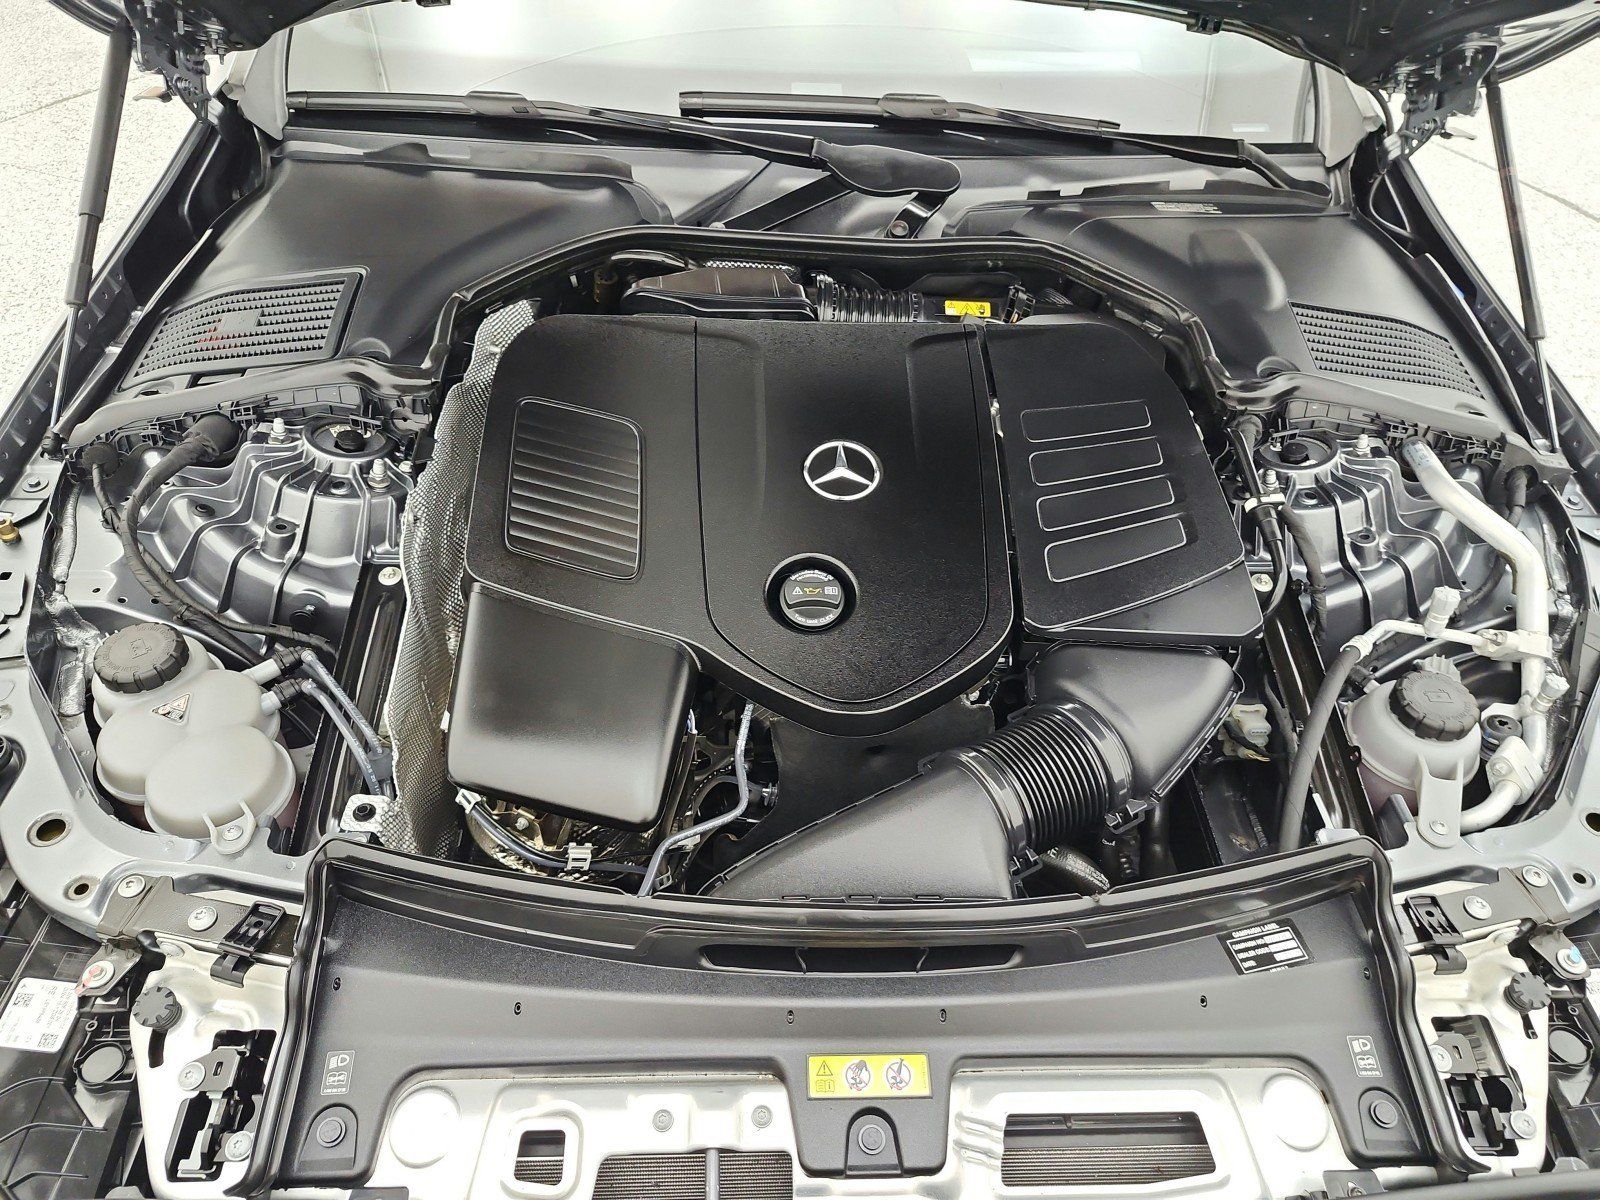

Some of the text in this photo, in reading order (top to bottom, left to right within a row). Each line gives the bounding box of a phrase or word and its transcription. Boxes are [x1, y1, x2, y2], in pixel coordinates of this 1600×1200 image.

[819, 613, 834, 623] CLICK
[1232, 922, 1280, 938] CAMPAIGN LABEL
[1232, 940, 1257, 950] CAMPAIGN
[1237, 949, 1257, 959] DEALER
